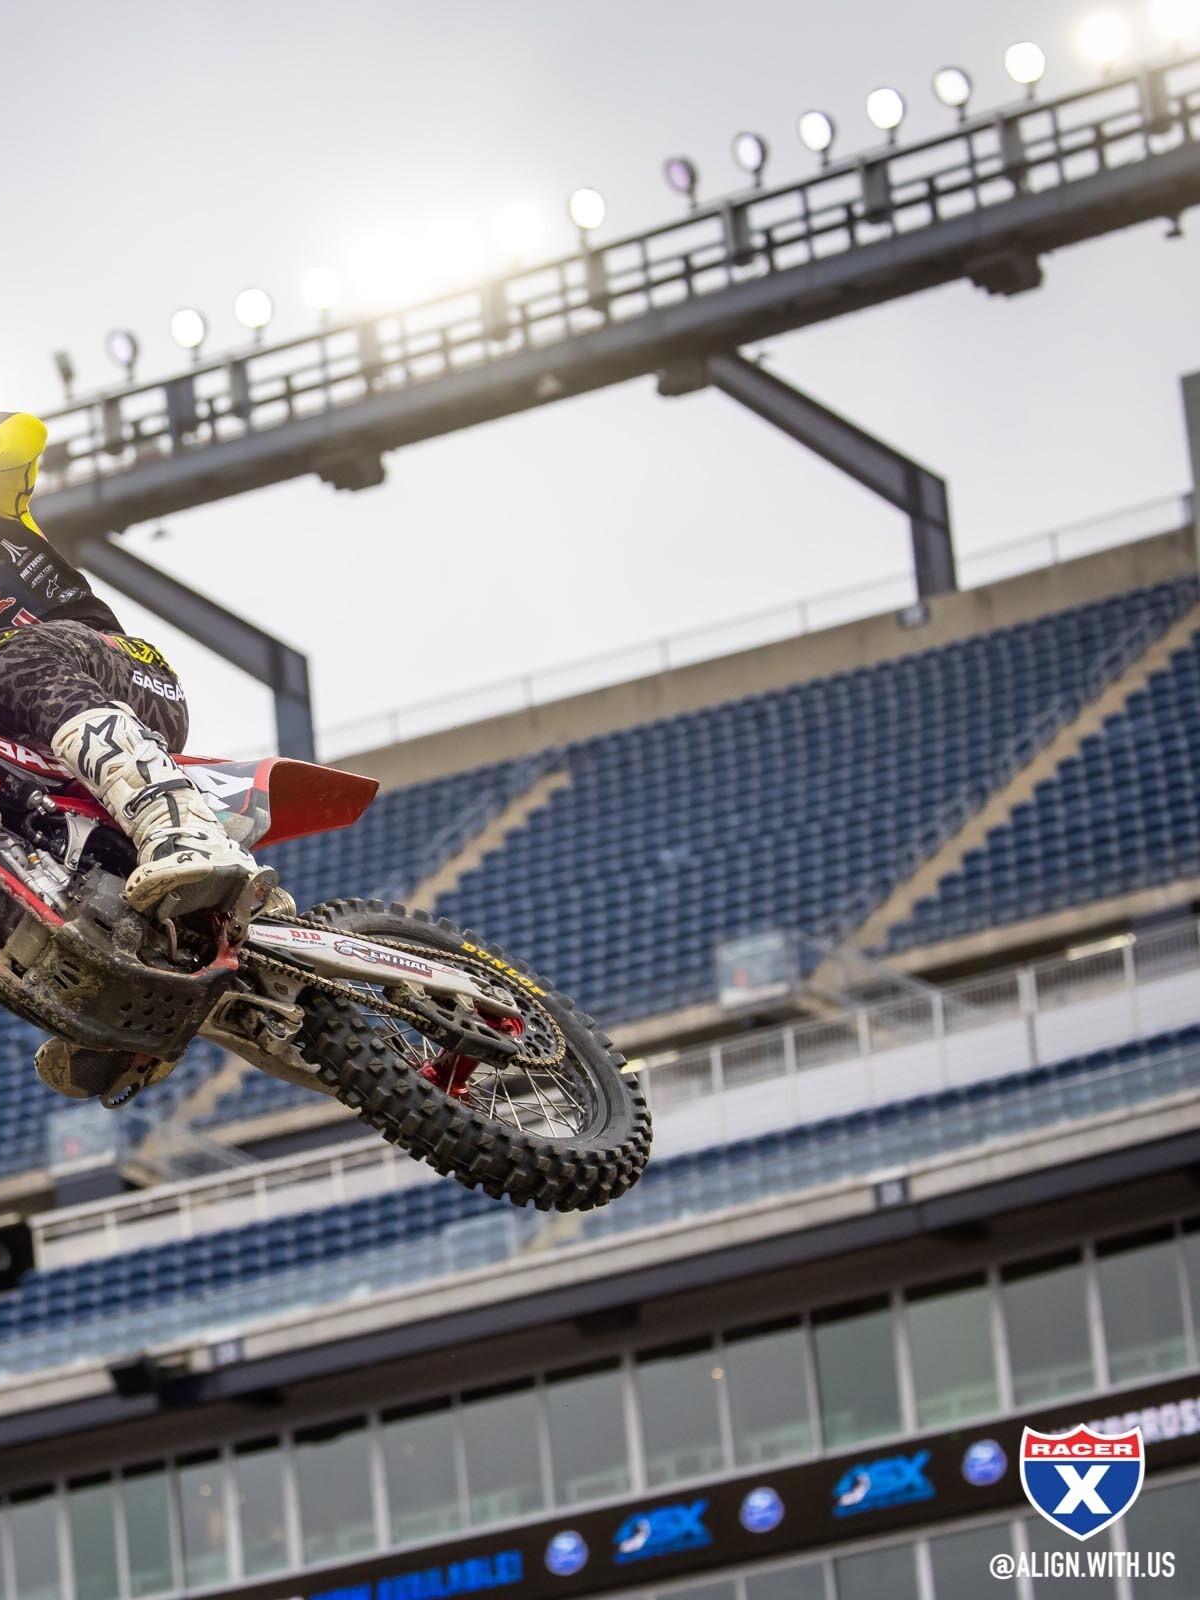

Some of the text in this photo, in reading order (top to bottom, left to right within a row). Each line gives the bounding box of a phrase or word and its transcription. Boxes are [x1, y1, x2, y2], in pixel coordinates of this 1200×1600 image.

[133, 670, 185, 701] GASGA
[289, 928, 321, 941] DID
[334, 939, 432, 974] RENTHAL
[461, 942, 547, 997] DUNLOP
